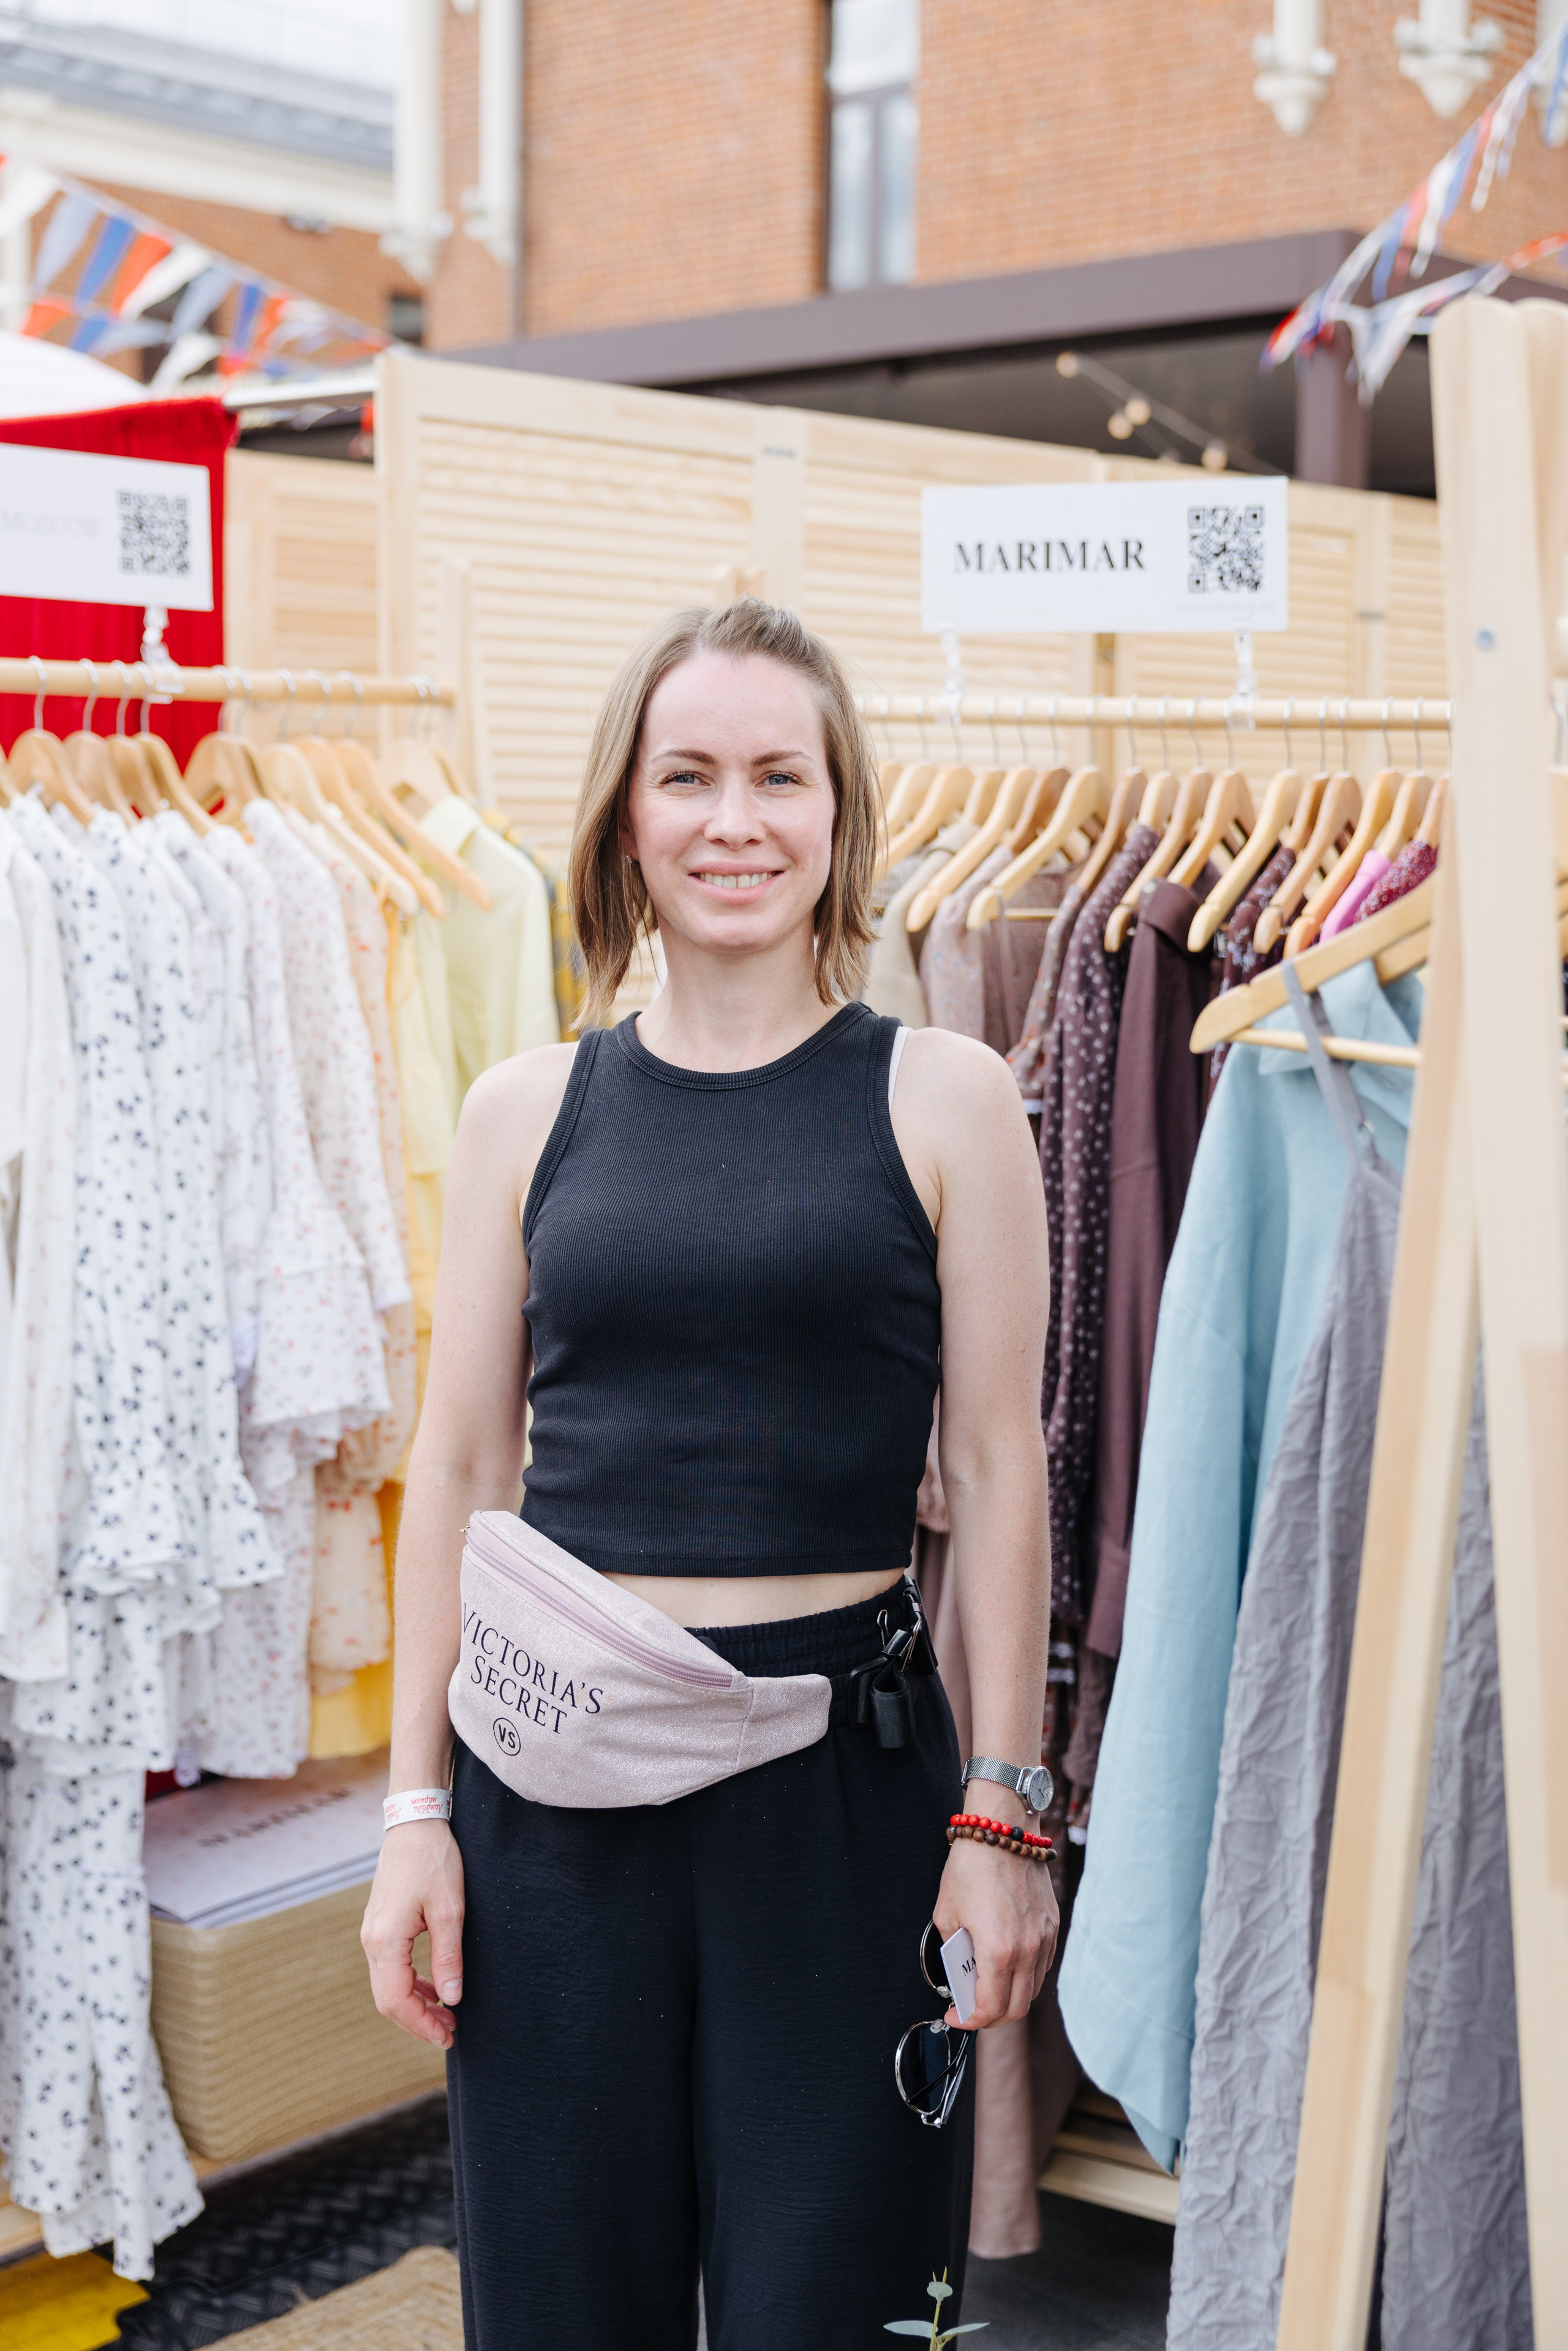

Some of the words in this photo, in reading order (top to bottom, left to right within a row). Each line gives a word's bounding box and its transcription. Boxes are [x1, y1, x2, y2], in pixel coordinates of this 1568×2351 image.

[953, 540, 1146, 573] MARIMAR
[463, 1601, 604, 1714] VICTORIA'S
[470, 1655, 567, 1734] SECRET
[498, 1723, 516, 1749] VS
